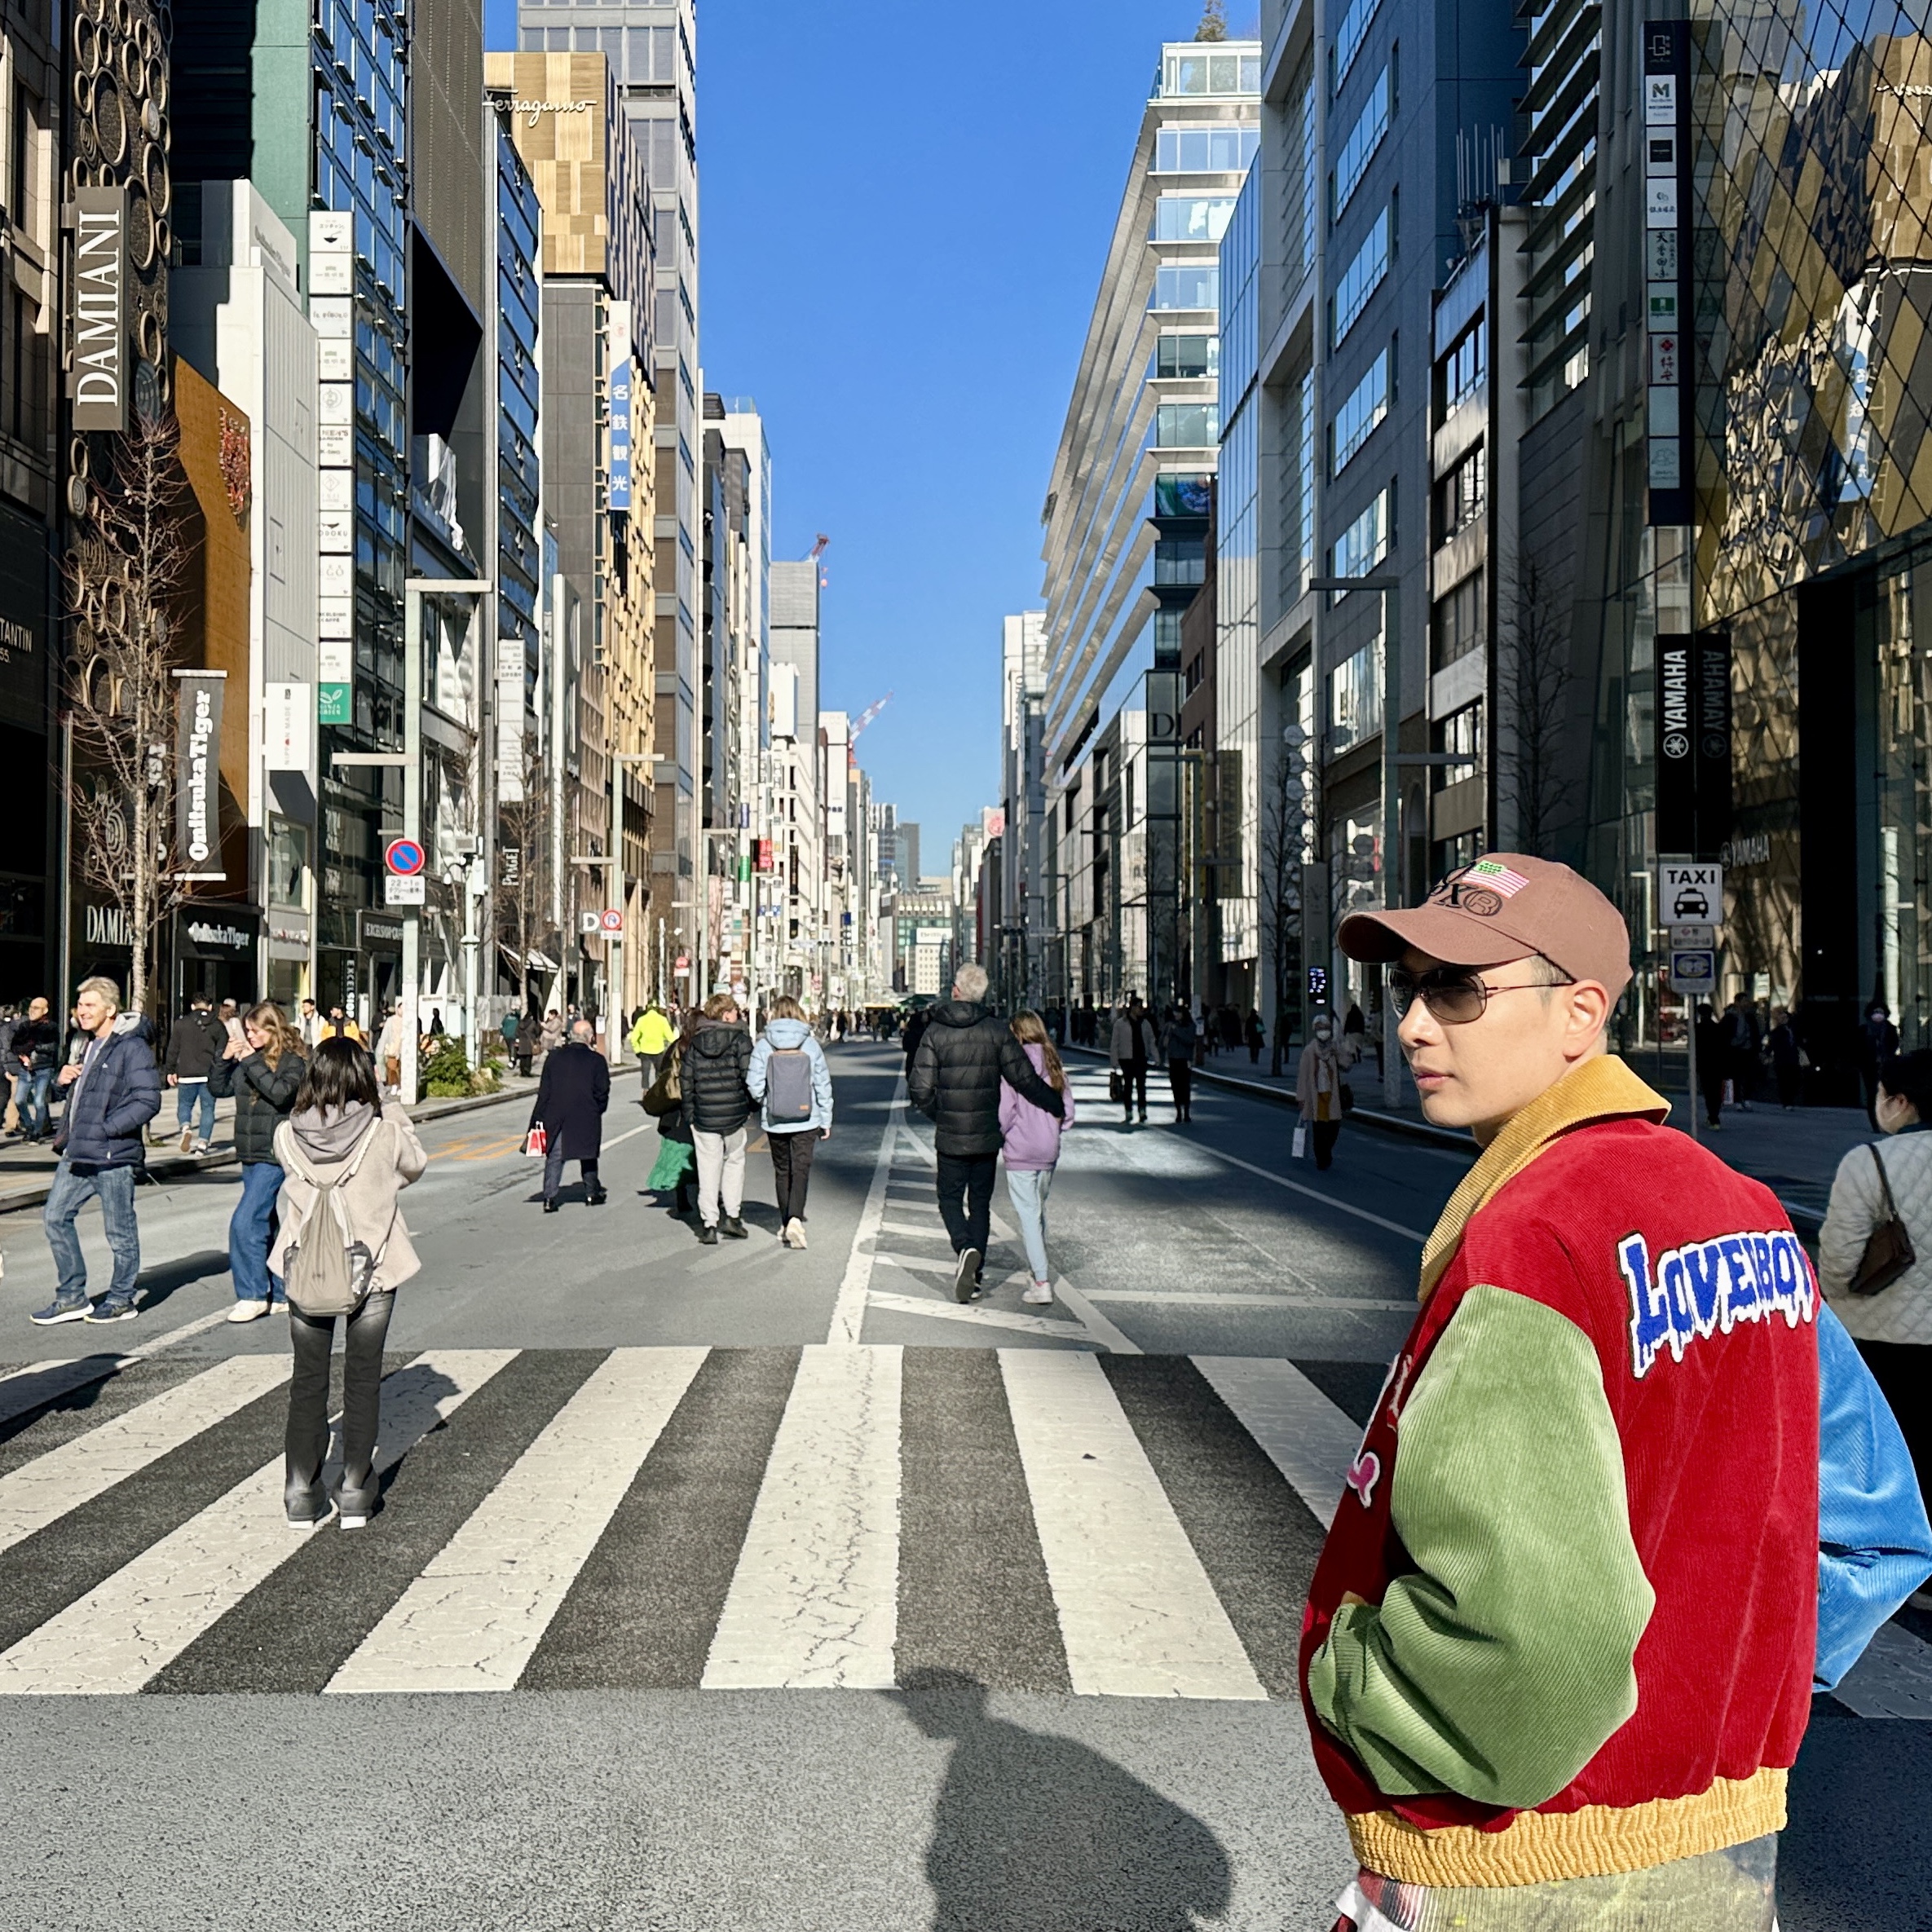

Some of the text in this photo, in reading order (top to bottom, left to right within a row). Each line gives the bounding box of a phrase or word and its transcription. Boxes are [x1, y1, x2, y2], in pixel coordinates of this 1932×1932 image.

[482, 89, 598, 127] Ferragamo
[77, 209, 120, 407] DAMIANI
[612, 384, 629, 492] 名鉄観光
[1664, 650, 1687, 732] YAMAHA
[501, 846, 520, 886] PIAGET
[1731, 834, 1770, 867] YAMAHA
[1667, 870, 1714, 884] TAXI
